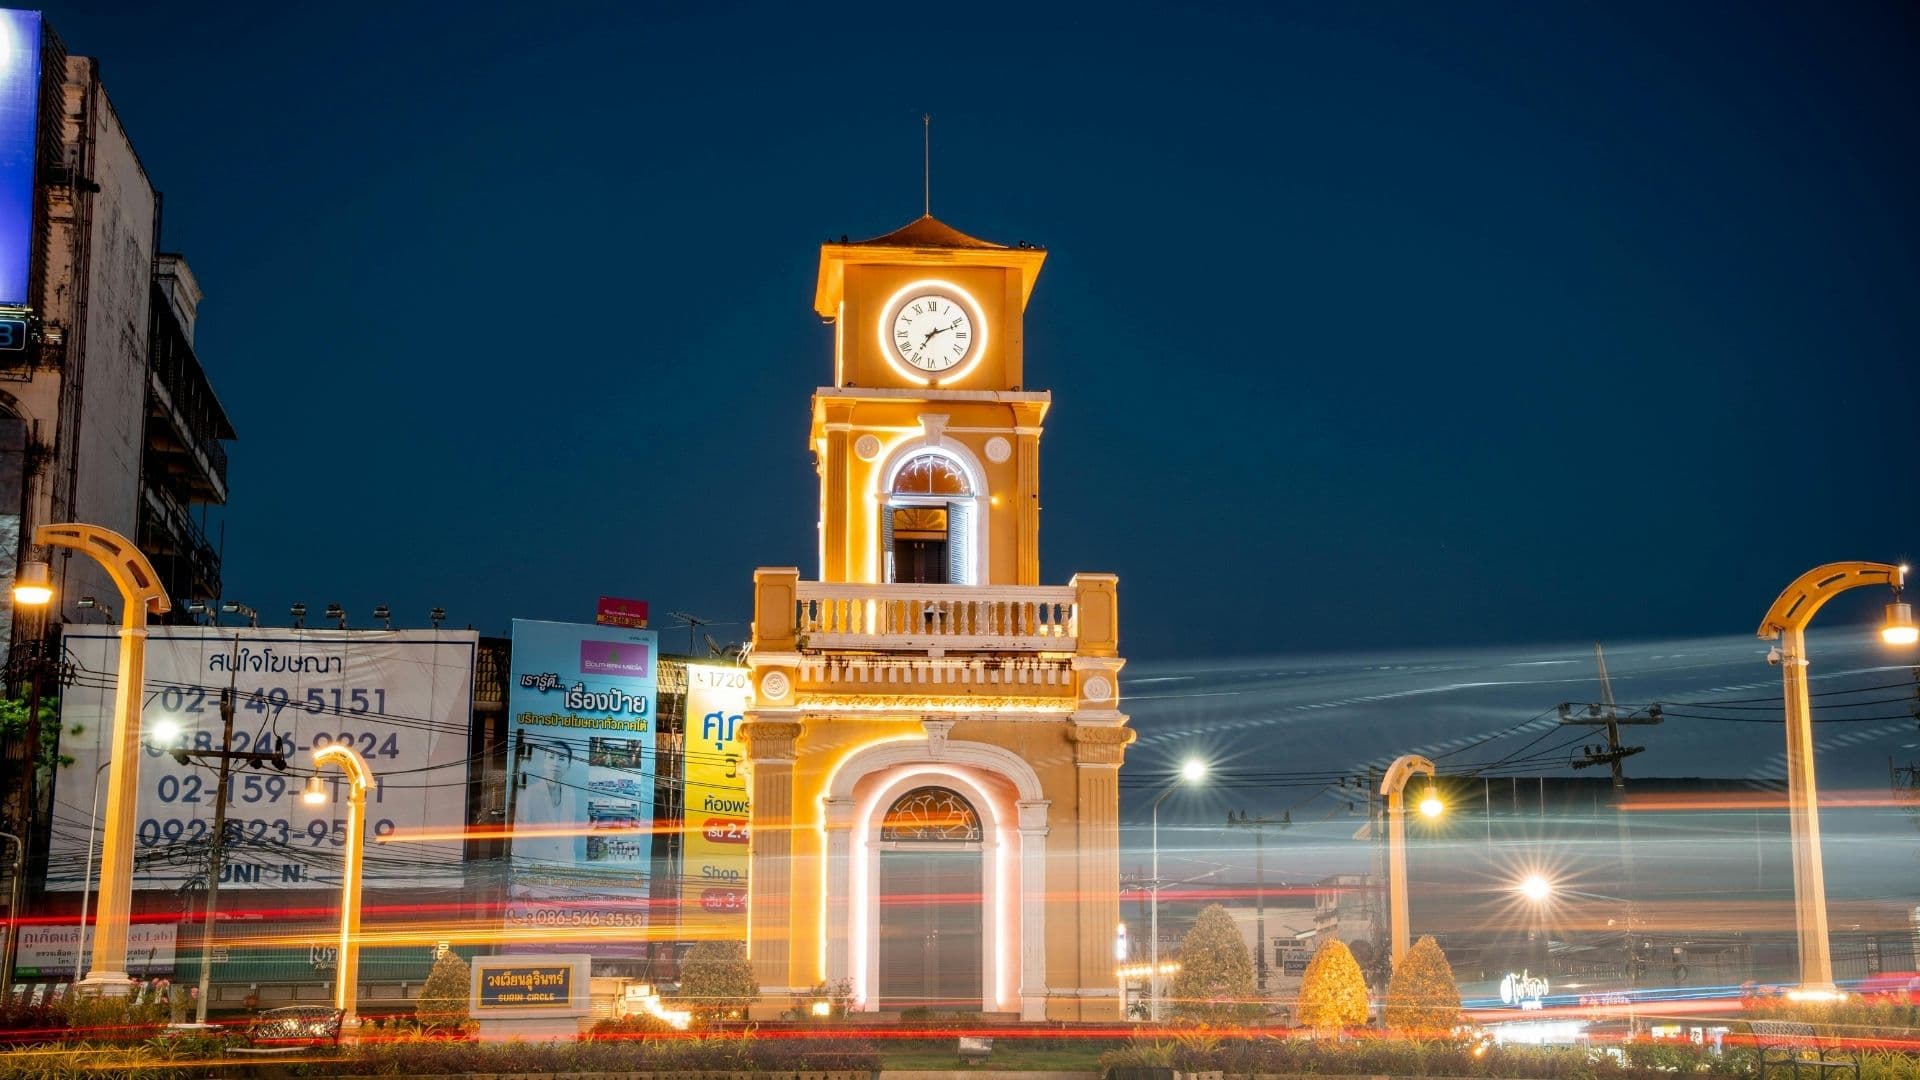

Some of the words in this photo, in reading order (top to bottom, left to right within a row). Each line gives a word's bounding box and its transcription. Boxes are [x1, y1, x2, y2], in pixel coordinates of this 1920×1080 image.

[209, 648, 343, 674] สนใจโฆษณา
[584, 660, 621, 669] SOUTHERN
[709, 672, 746, 689] 1720
[564, 682, 646, 714] เรื่องป้าย
[702, 865, 739, 883] Shop
[488, 969, 564, 991] วงเวียนสุรินทร์
[498, 993, 524, 1002] SURIN
[526, 992, 556, 1001] CIRCLE
